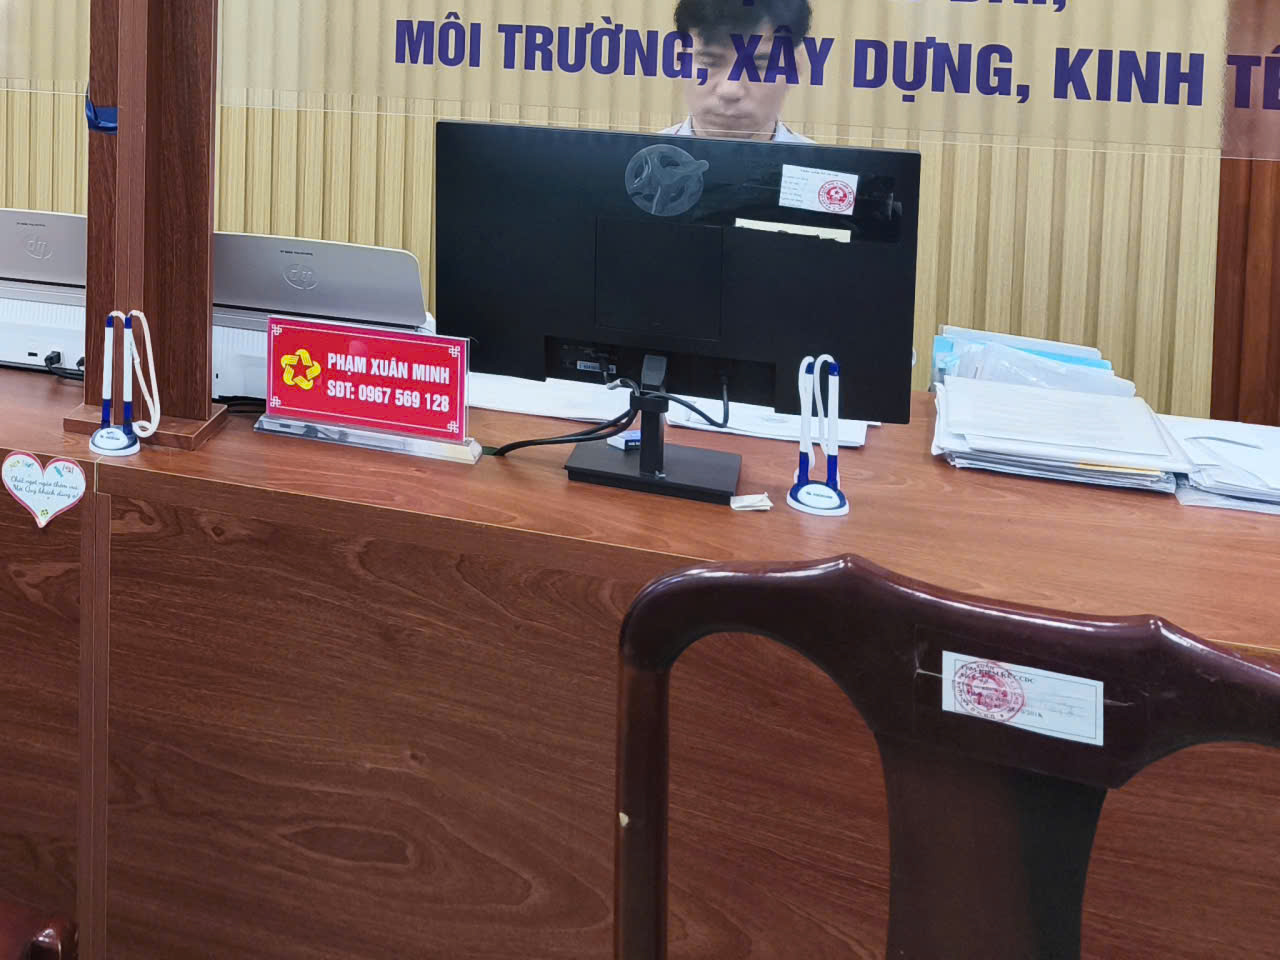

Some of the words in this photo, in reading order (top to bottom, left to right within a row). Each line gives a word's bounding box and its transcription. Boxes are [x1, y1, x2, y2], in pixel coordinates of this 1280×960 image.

[395, 12, 481, 67] MÔI
[498, 16, 708, 86] TRƯỜNG,
[727, 25, 835, 86] XÂY
[853, 36, 1030, 104] DỰNG,
[1053, 47, 1205, 106] KINH
[327, 352, 367, 375] PHẠM
[370, 357, 408, 379] XUÂN
[412, 363, 450, 385] MINH
[327, 380, 355, 399] SĐT:
[358, 384, 391, 404] 0967
[395, 389, 420, 408] 569
[424, 393, 450, 412] 128
